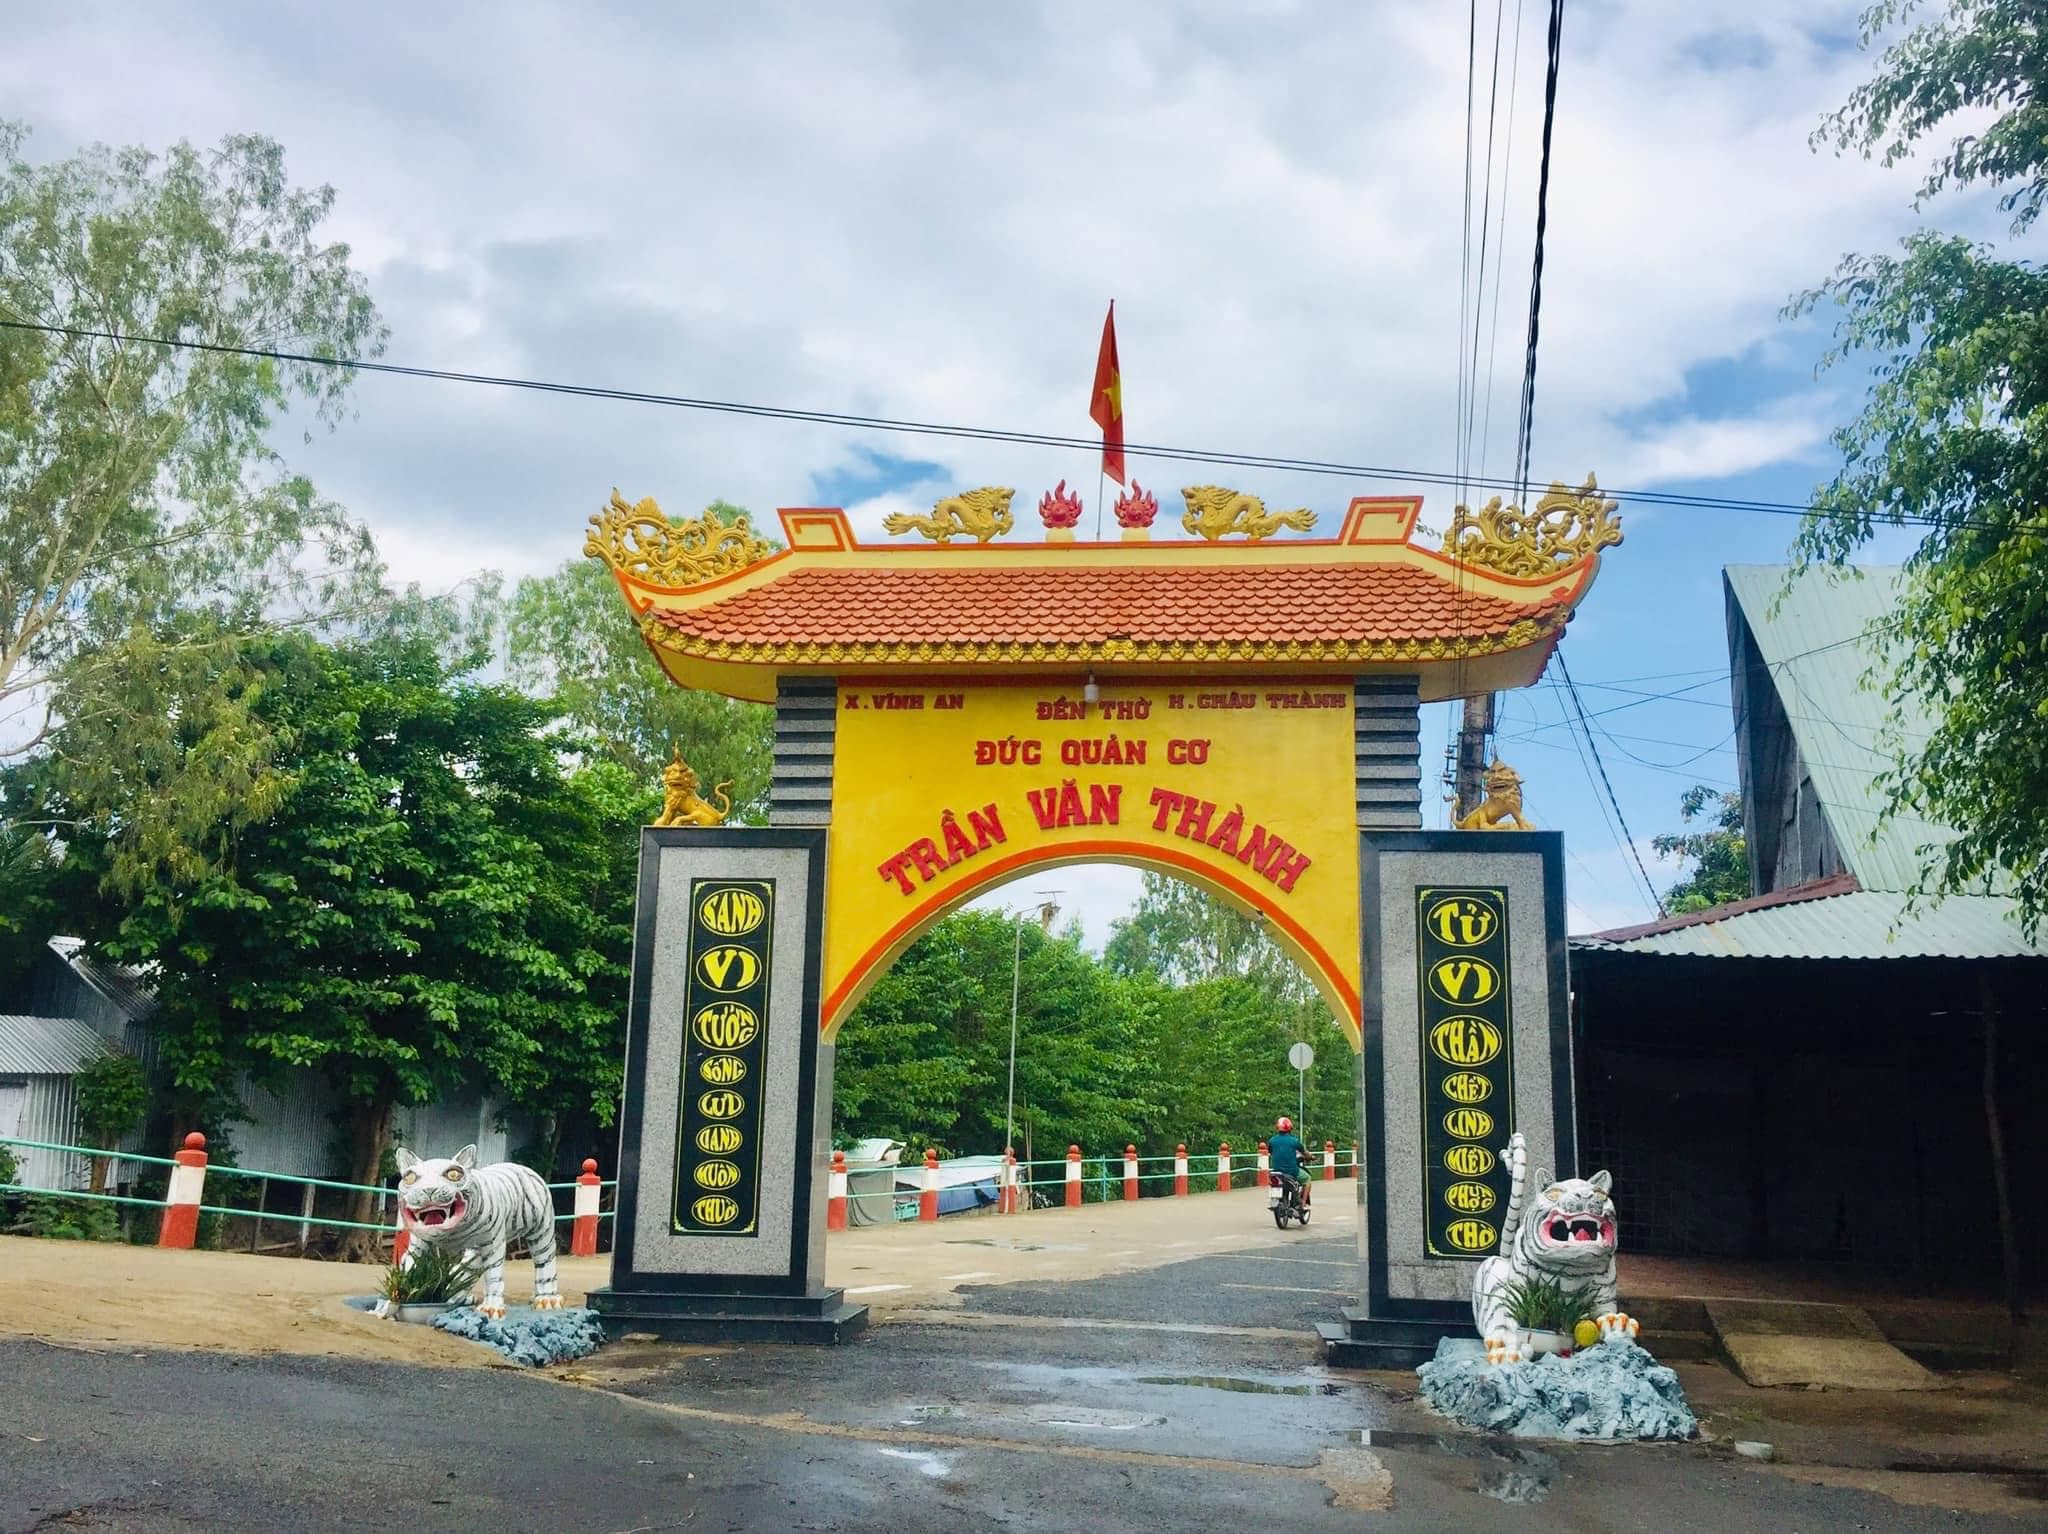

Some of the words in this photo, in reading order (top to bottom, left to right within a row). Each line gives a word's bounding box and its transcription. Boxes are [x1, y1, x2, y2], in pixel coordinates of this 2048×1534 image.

[933, 694, 964, 710] AN
[1099, 696, 1153, 720] THỜ
[1265, 690, 1346, 709] THÀNH
[975, 735, 1041, 765] ĐỨC
[1061, 734, 1147, 766] QUẢN
[1167, 739, 1211, 765] CƠ
[877, 802, 1007, 896] TRẦN
[1026, 778, 1122, 829] VĂN
[1149, 787, 1312, 894] THÀNH
[703, 892, 762, 933] SANH
[1433, 902, 1491, 943] TỬ
[703, 949, 756, 988] VI
[1437, 961, 1492, 1000] VI
[698, 1005, 754, 1047] TƯỚNG
[1434, 1020, 1498, 1062] THẦN
[703, 1057, 744, 1082] SỐNG
[1444, 1074, 1489, 1101] CHẾT
[701, 1093, 742, 1116] LƯU
[1447, 1110, 1491, 1136] LINH
[699, 1128, 740, 1152] DANH
[1447, 1147, 1491, 1174] MIẾU
[696, 1163, 738, 1186] MUÔN
[1448, 1222, 1494, 1248] THỜ
